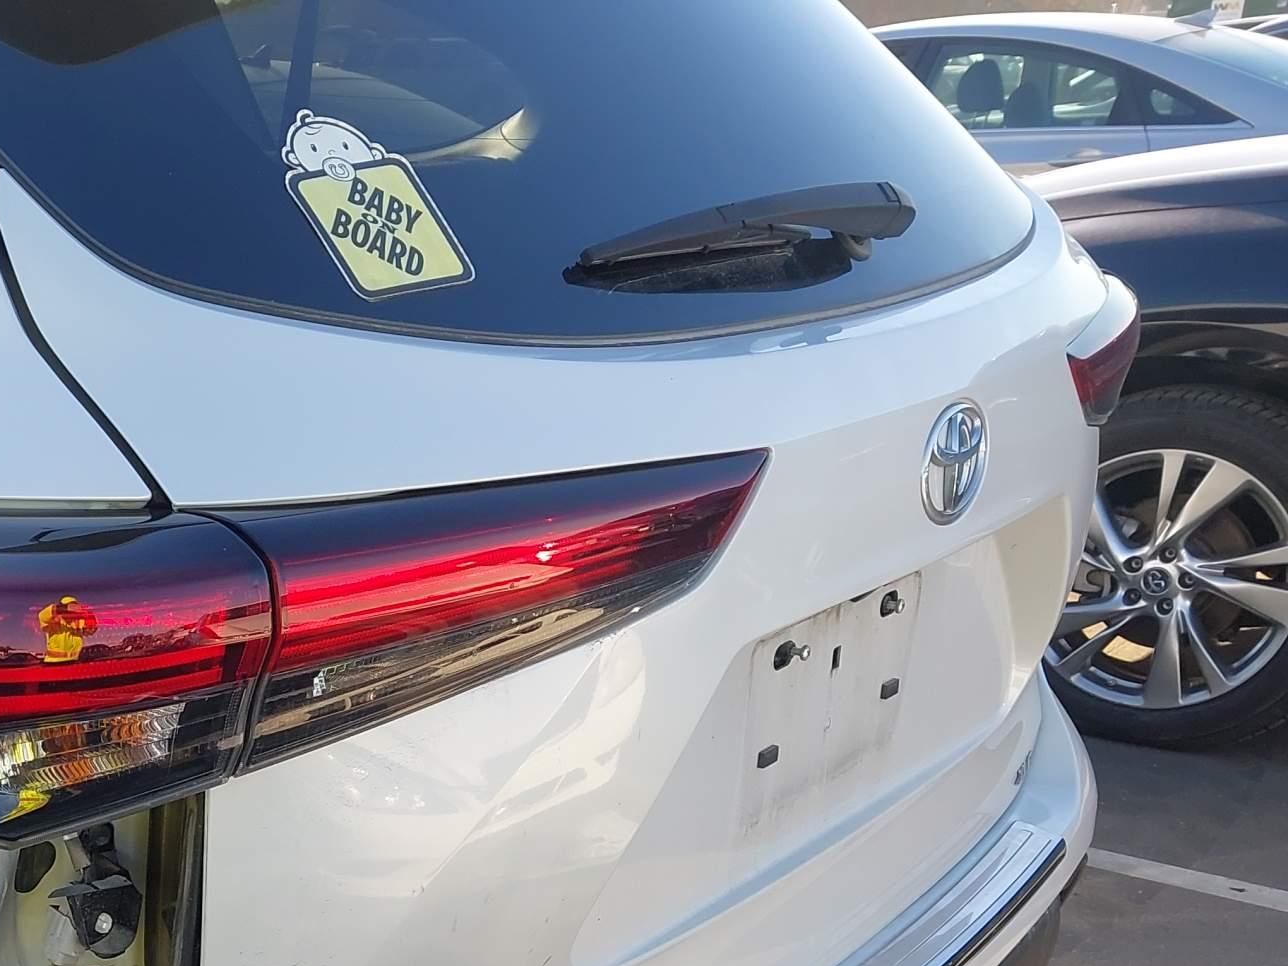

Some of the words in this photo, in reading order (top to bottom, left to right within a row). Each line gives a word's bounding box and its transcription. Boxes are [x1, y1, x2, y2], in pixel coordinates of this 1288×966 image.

[347, 176, 423, 234] BABY
[361, 212, 399, 235] ON
[330, 207, 425, 277] BOARD
